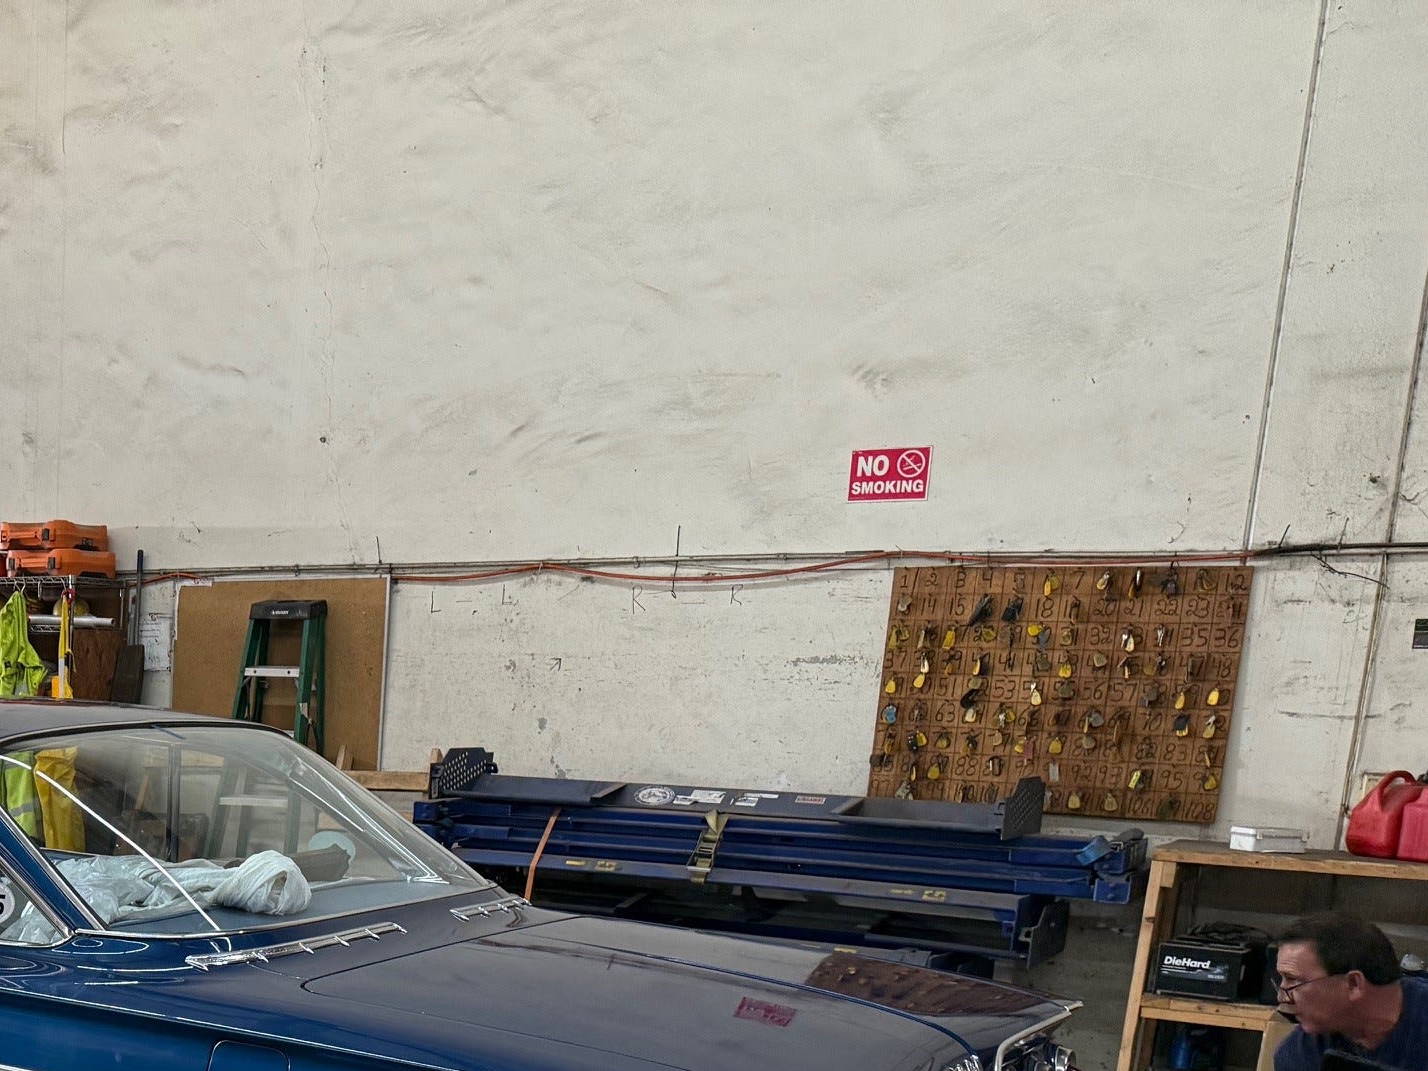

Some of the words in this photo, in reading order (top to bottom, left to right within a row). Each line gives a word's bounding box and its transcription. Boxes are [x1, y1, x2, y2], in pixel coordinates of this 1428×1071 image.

[856, 454, 890, 477] NO
[851, 479, 924, 495] SMOKING
[900, 575, 909, 588] 1
[924, 572, 938, 586] 2
[982, 569, 993, 588] 4
[1072, 570, 1085, 590] 7
[731, 584, 743, 605] R
[921, 598, 936, 616] 14
[949, 598, 966, 616] 15
[1035, 598, 1054, 619] 18
[1093, 599, 1117, 616] 20
[1124, 599, 1144, 618] 21
[1155, 599, 1180, 616] 22
[1186, 597, 1209, 618] 23
[1090, 627, 1111, 645] 32
[1182, 627, 1207, 647] 35
[1214, 627, 1239, 648] 36
[884, 650, 907, 668] 37
[1213, 657, 1233, 677] 48
[937, 678, 956, 697] 51
[993, 680, 1016, 699] 53
[1081, 681, 1105, 700] 56
[1110, 682, 1138, 702] 57
[936, 702, 955, 722] 63
[1164, 743, 1187, 760] 83
[955, 757, 978, 776] 88
[1161, 770, 1183, 790] 95
[1185, 801, 1215, 820] 108
[1164, 956, 1211, 969] DieHard
